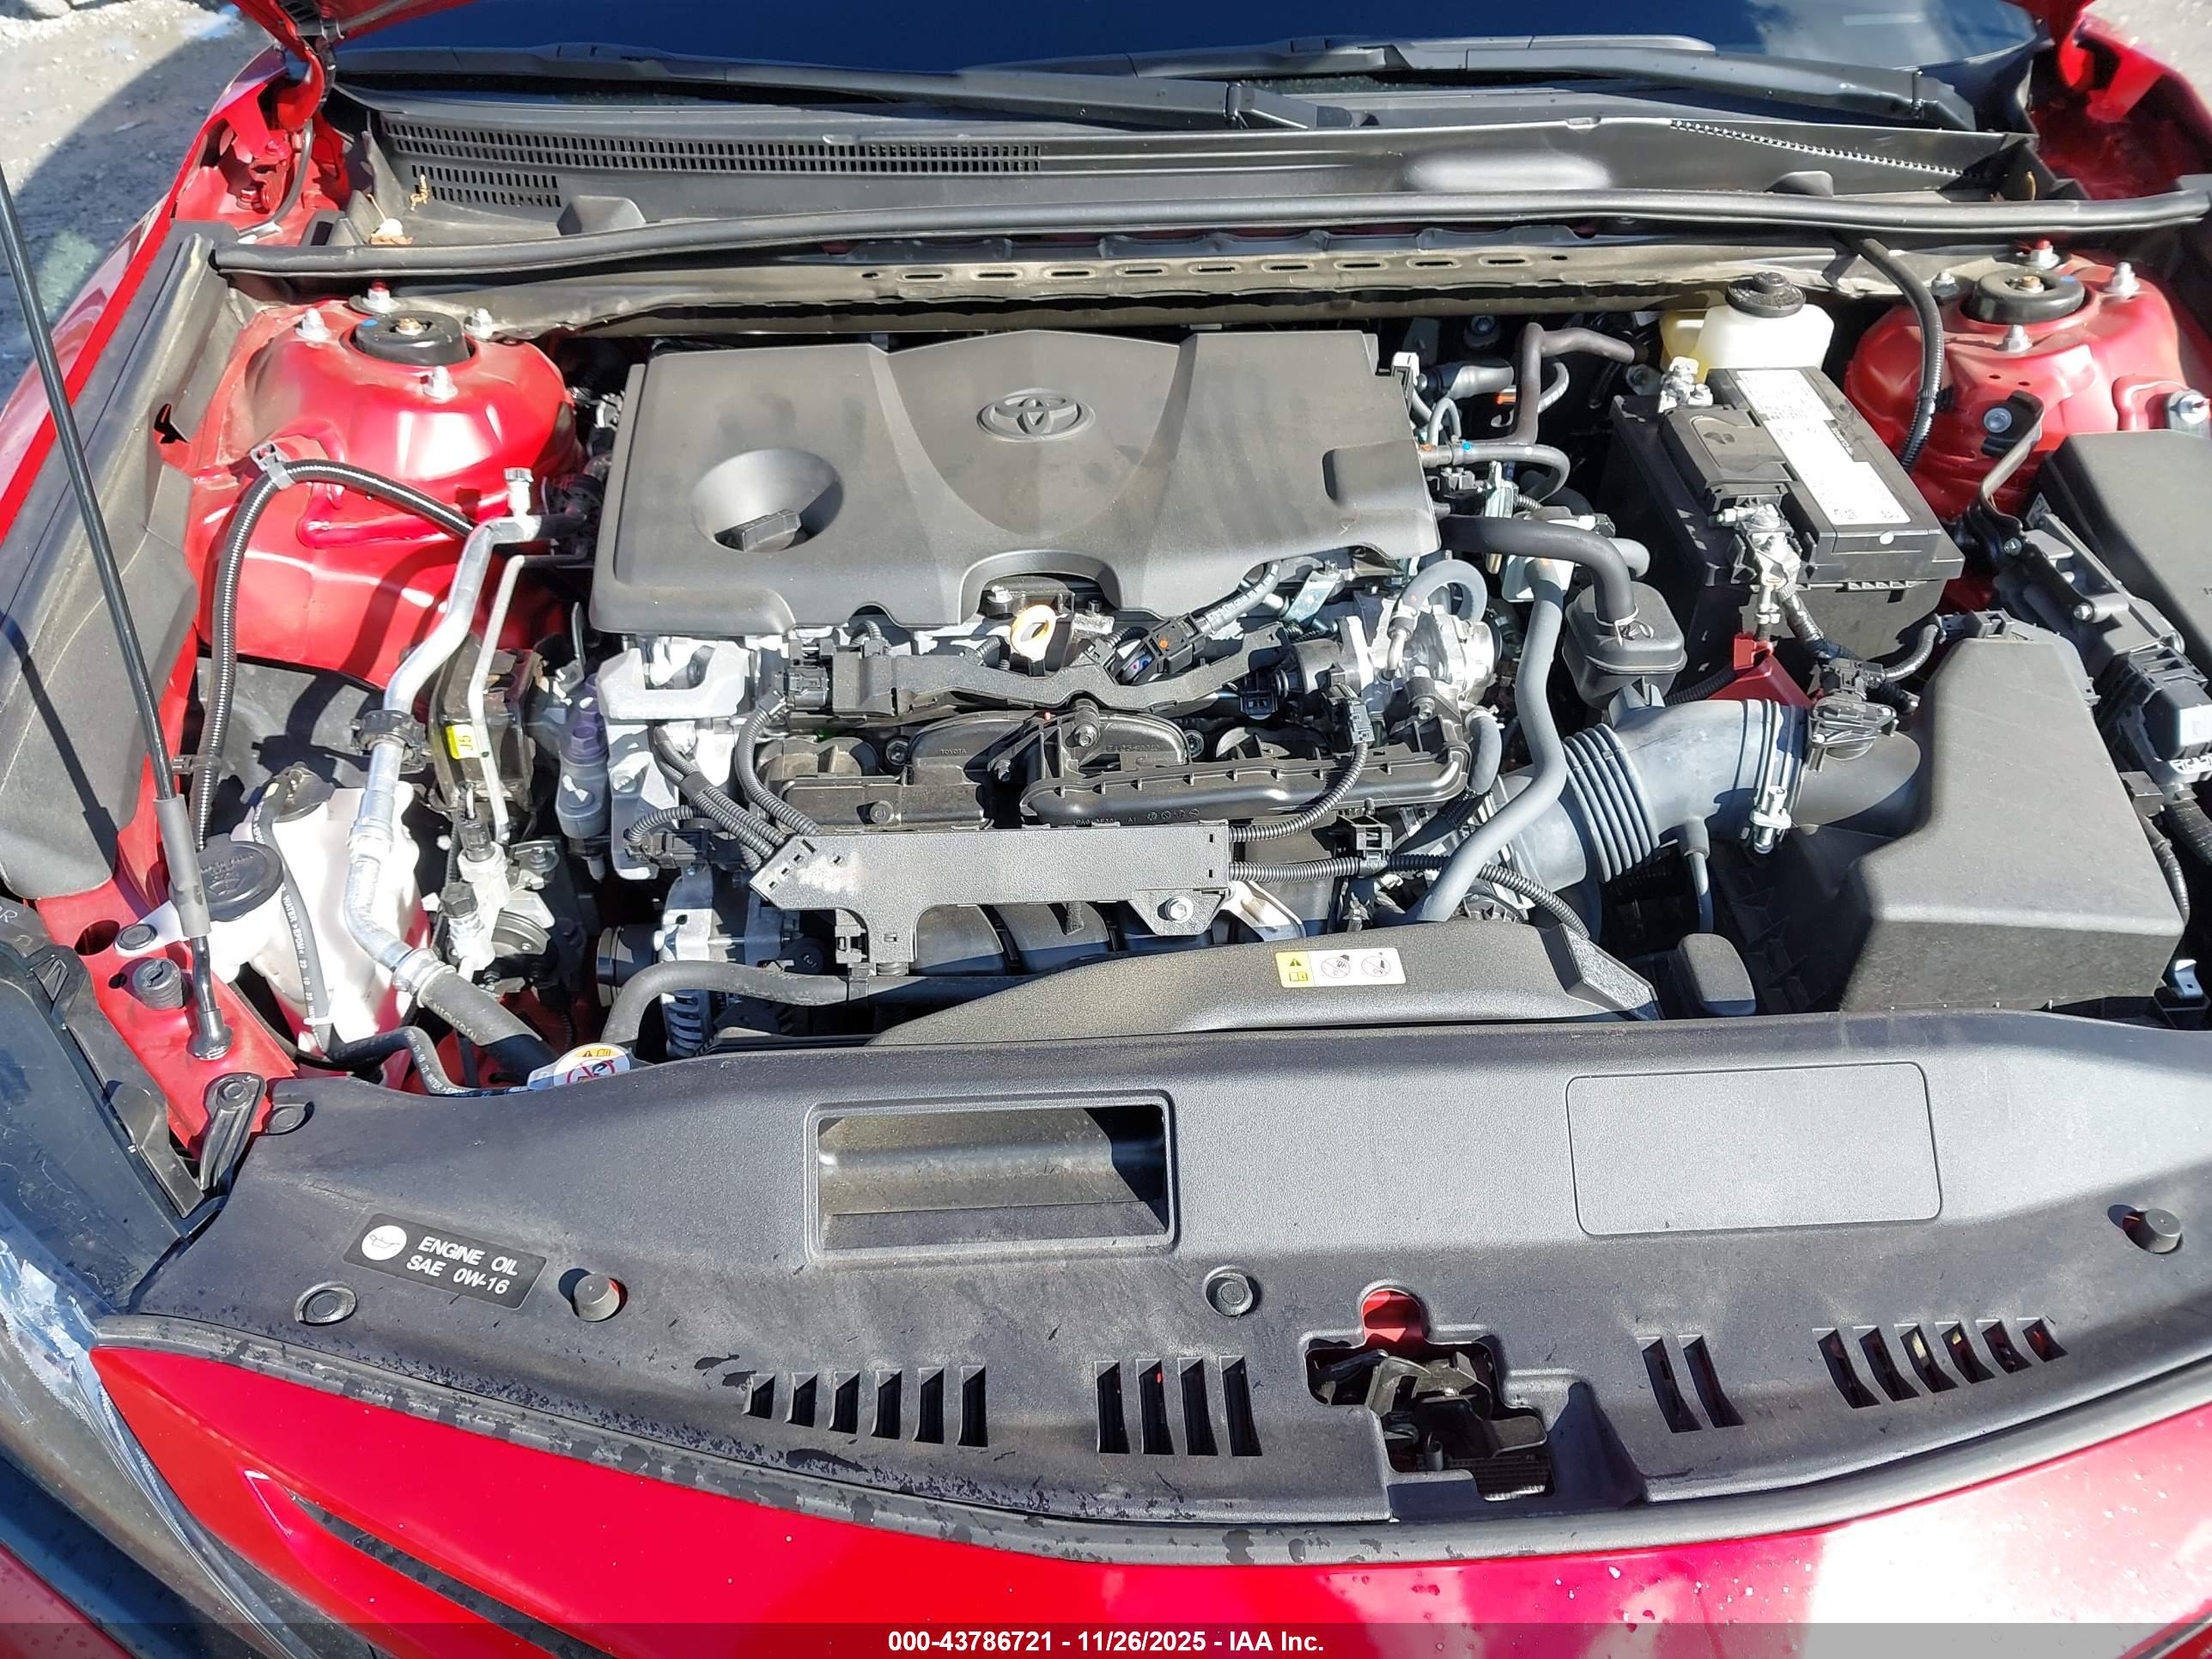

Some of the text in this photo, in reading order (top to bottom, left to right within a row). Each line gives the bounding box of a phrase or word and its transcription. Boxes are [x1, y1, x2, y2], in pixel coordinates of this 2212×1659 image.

[282, 894, 297, 922] WATER
[406, 1255, 510, 1295] SAE 0W-16
[417, 1236, 519, 1276] ENGINE OIL
